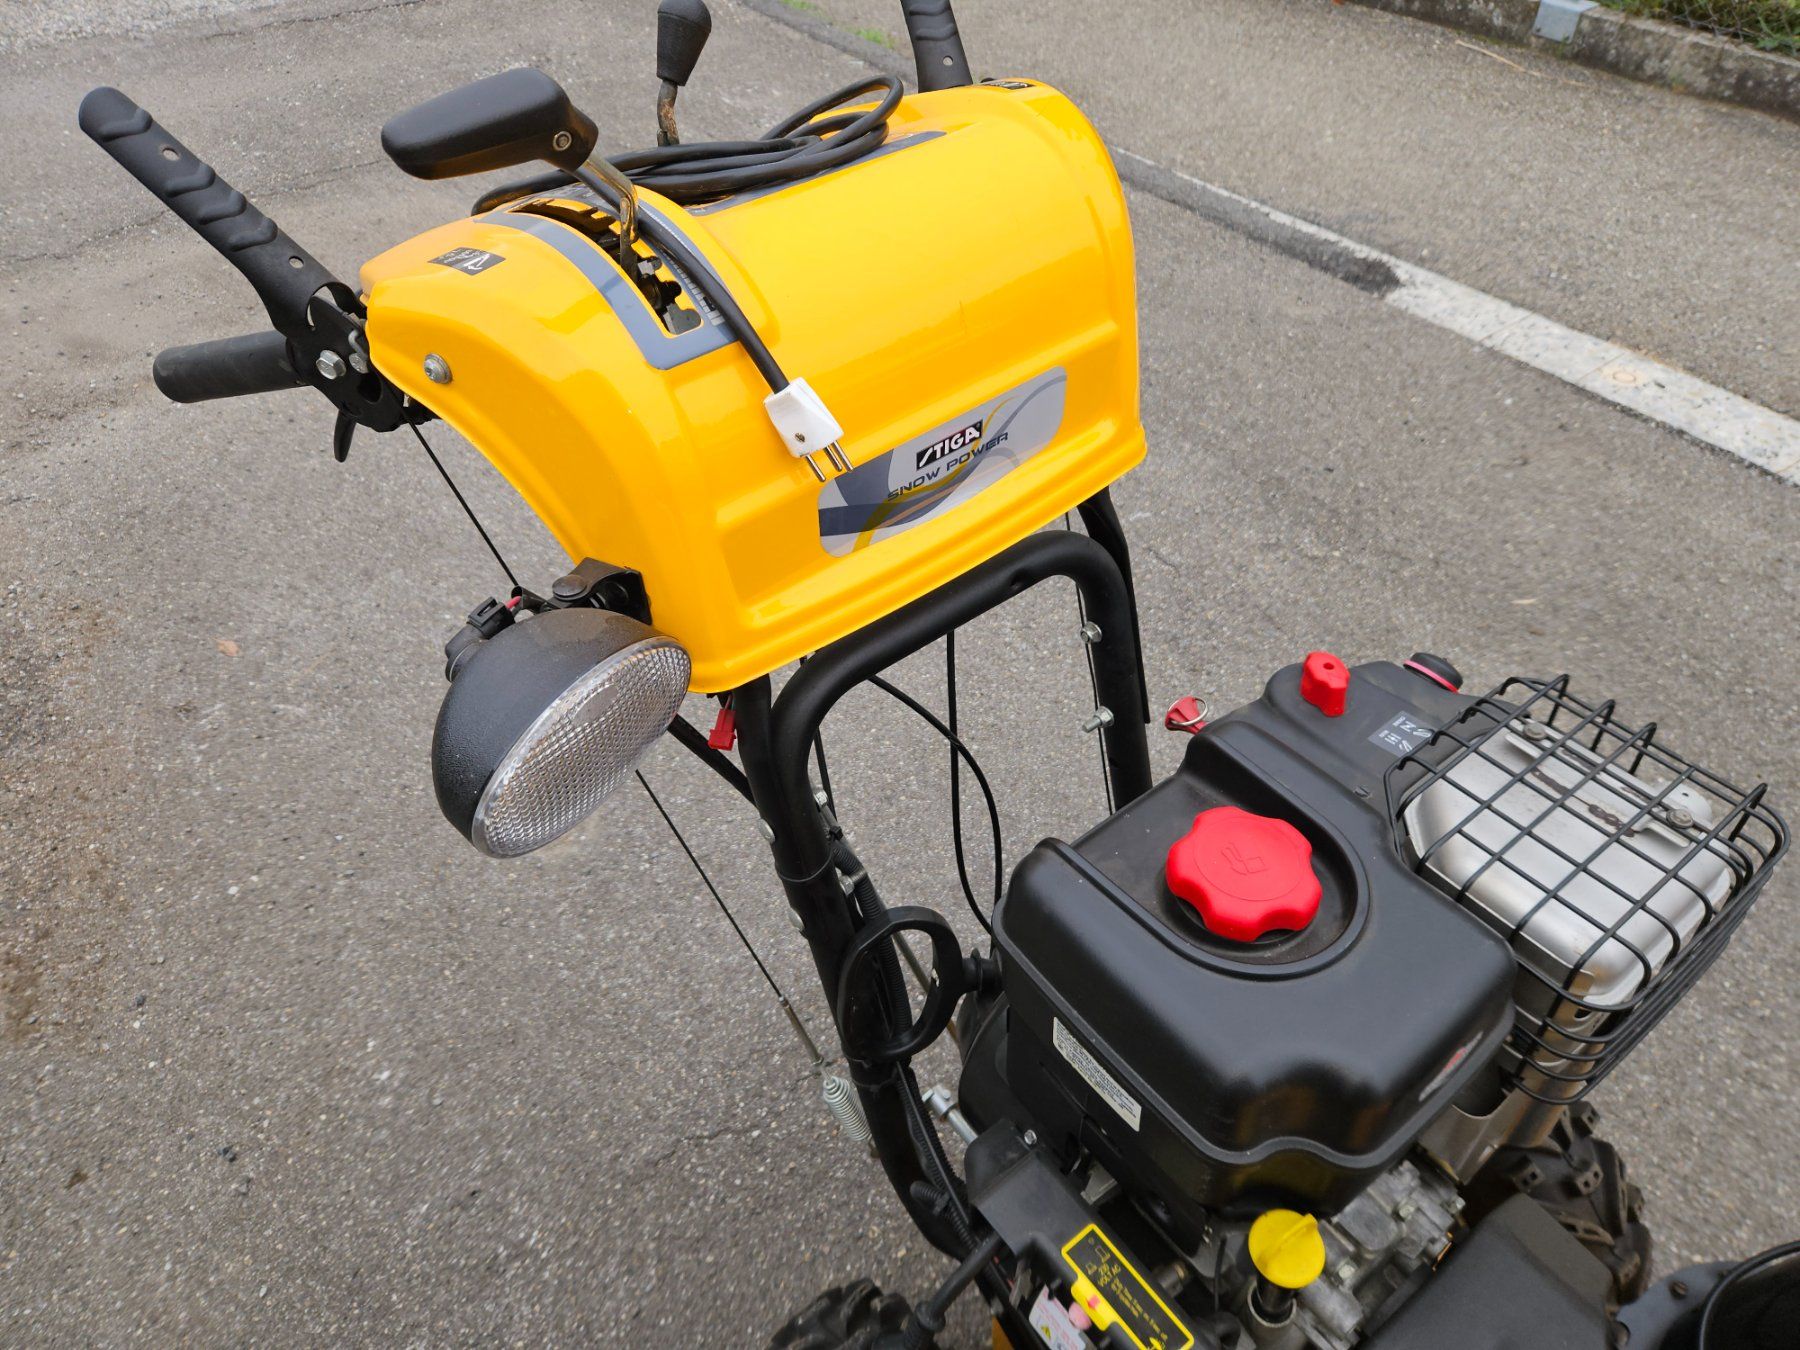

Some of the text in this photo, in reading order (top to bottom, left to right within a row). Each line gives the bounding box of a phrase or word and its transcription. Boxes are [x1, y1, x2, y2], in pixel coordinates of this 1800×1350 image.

[887, 431, 1009, 501] SNOW POWER
[918, 426, 980, 469] STIGA
